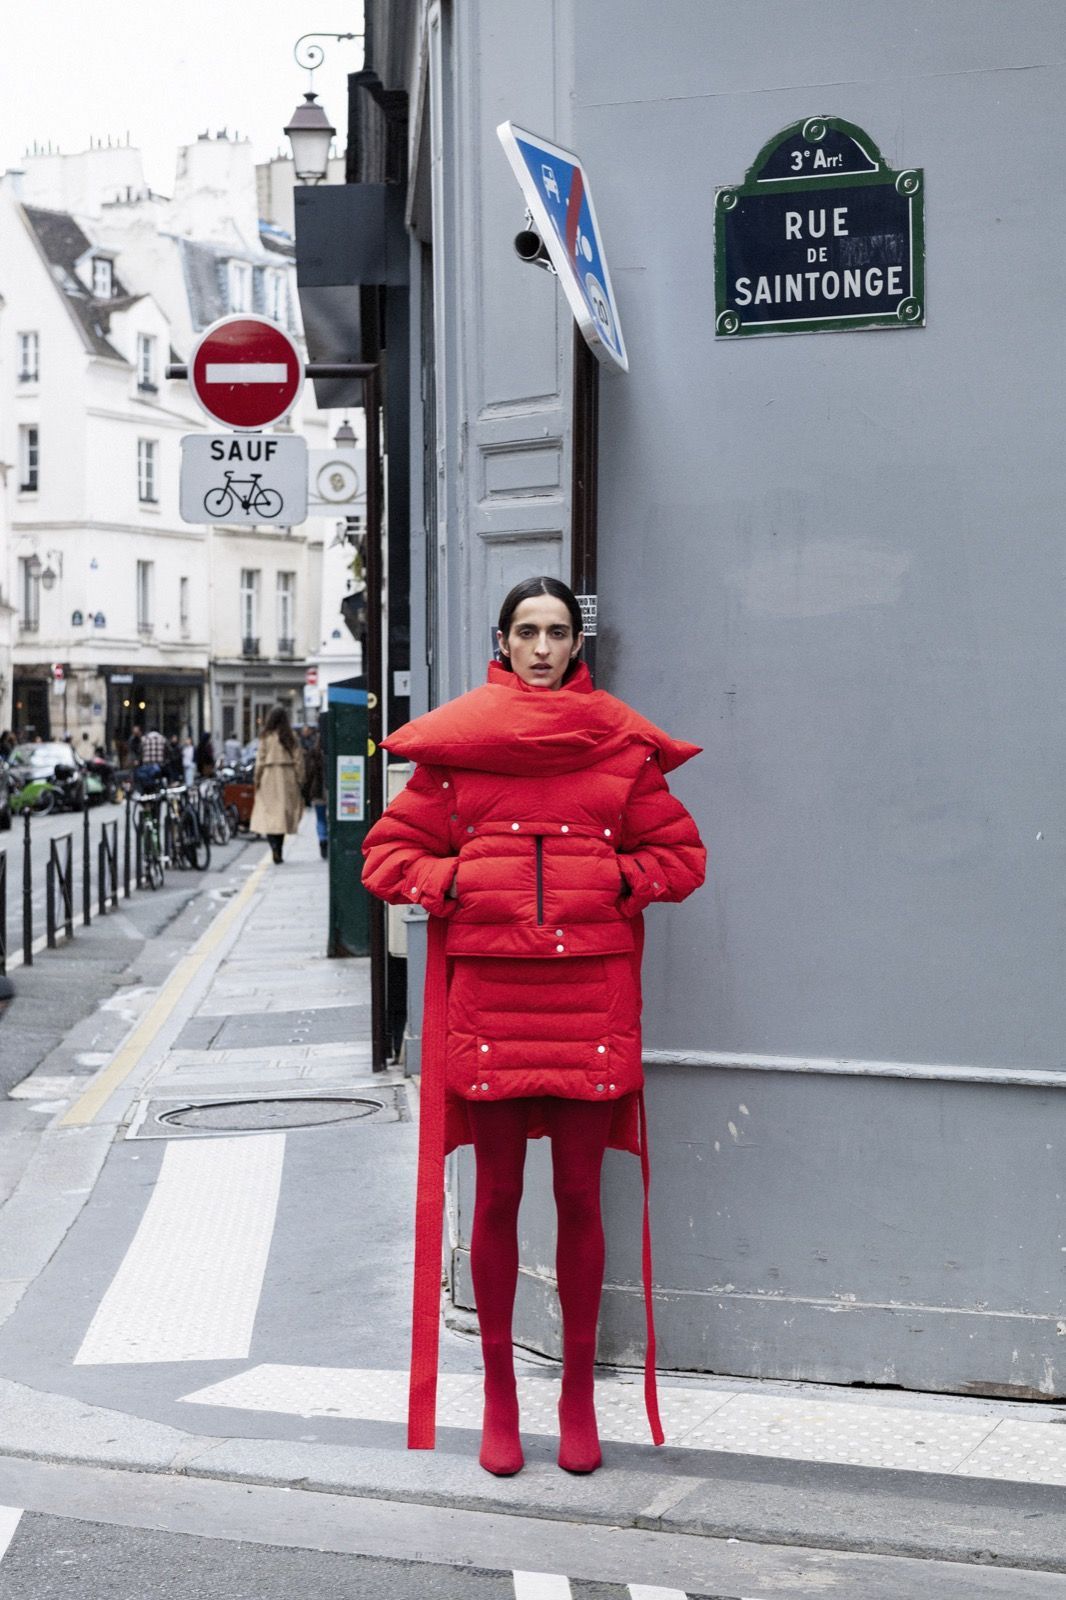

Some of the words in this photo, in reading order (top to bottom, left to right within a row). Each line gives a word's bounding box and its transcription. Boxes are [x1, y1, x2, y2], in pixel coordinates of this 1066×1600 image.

[785, 207, 849, 240] RUE
[807, 247, 828, 263] DE
[734, 266, 903, 306] SAINTONGE
[210, 439, 278, 462] SAUF
